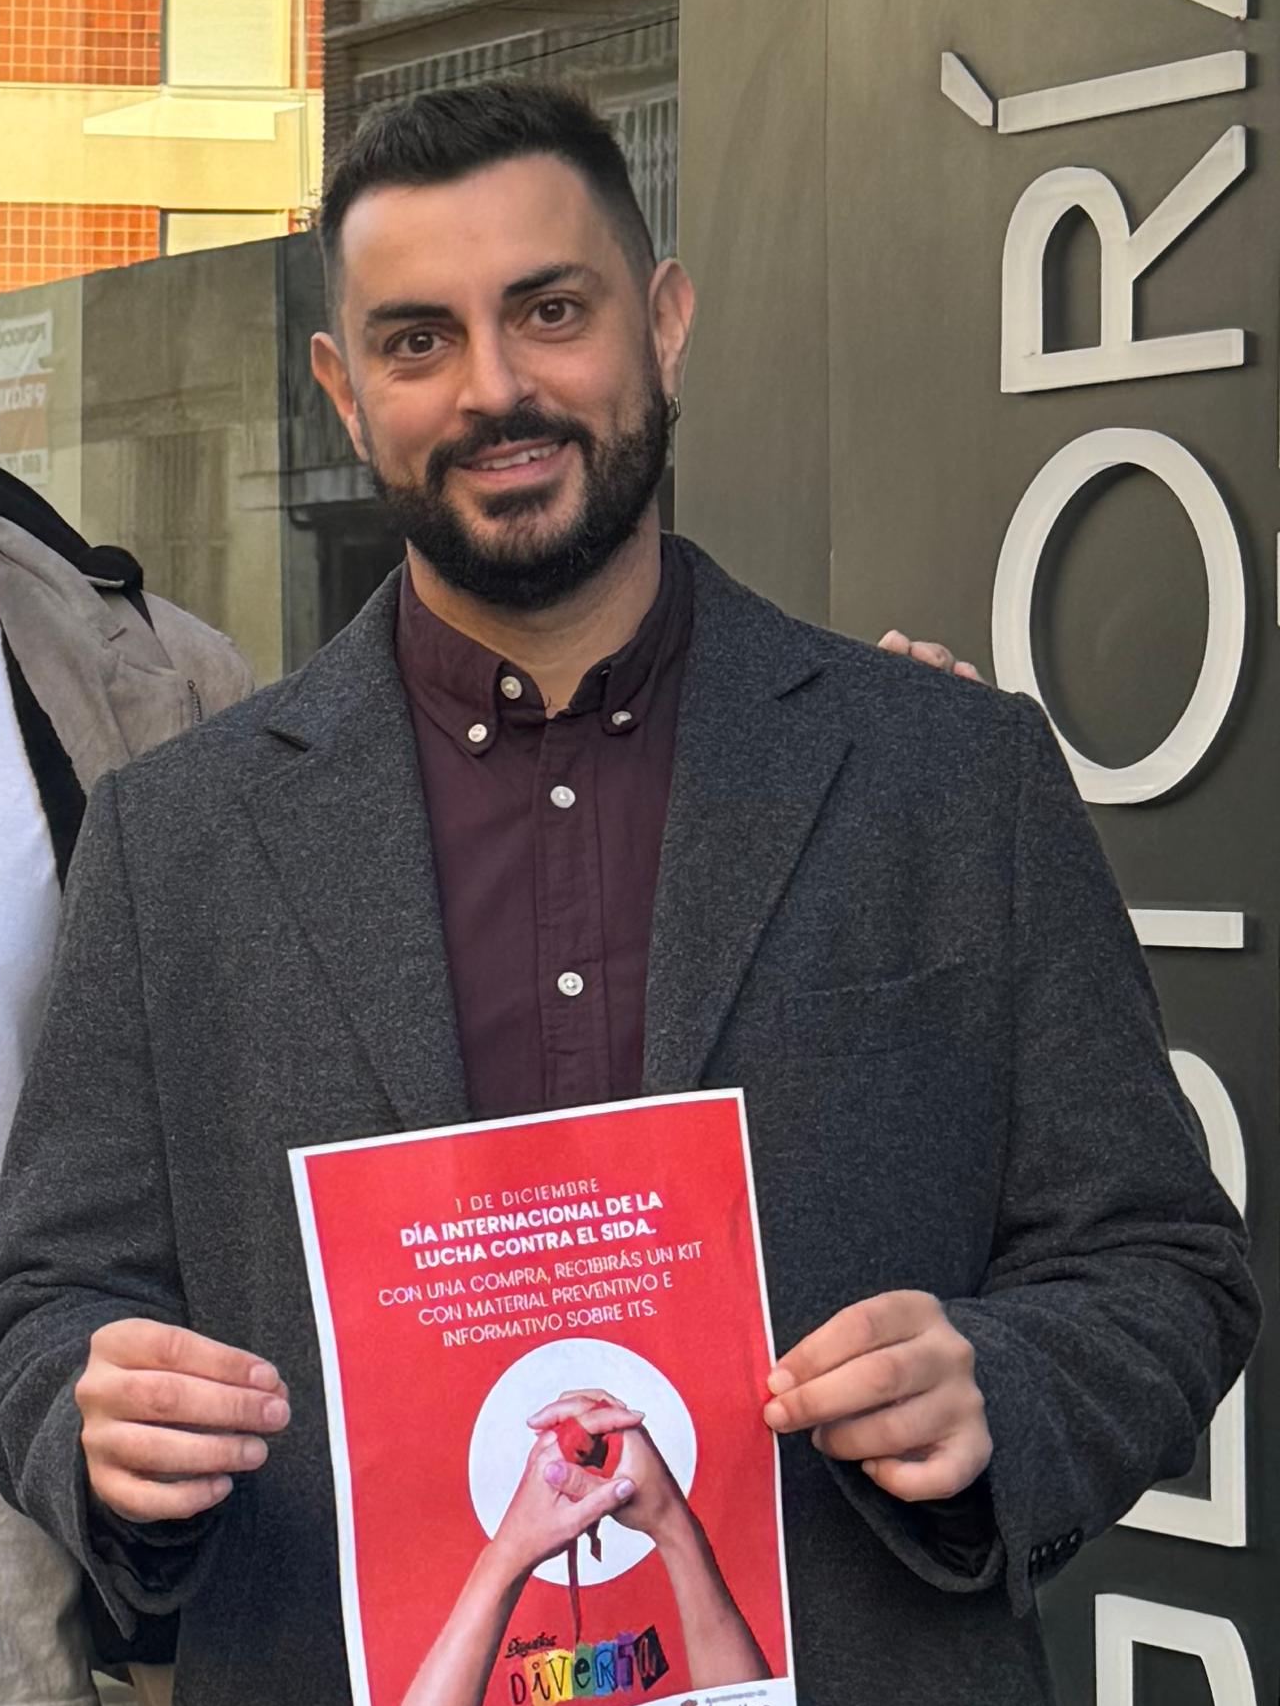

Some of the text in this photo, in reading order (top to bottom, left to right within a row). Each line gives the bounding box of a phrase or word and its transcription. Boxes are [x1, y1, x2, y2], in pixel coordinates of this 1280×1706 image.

[400, 1191, 664, 1247] DÍA INTERNACIONAL DE LA
[454, 1177, 600, 1214] 1 DE DICIEMBRE
[414, 1218, 657, 1271] LUCHA CONTRA EL SIDA.
[378, 1241, 703, 1307] CON UNA COMPRA, RECIBIRÁS UN KIT
[418, 1271, 674, 1326] CON MATERIAL PREVENTIVO E
[442, 1299, 658, 1348] INFORMATIVO SOBRE ITS.
